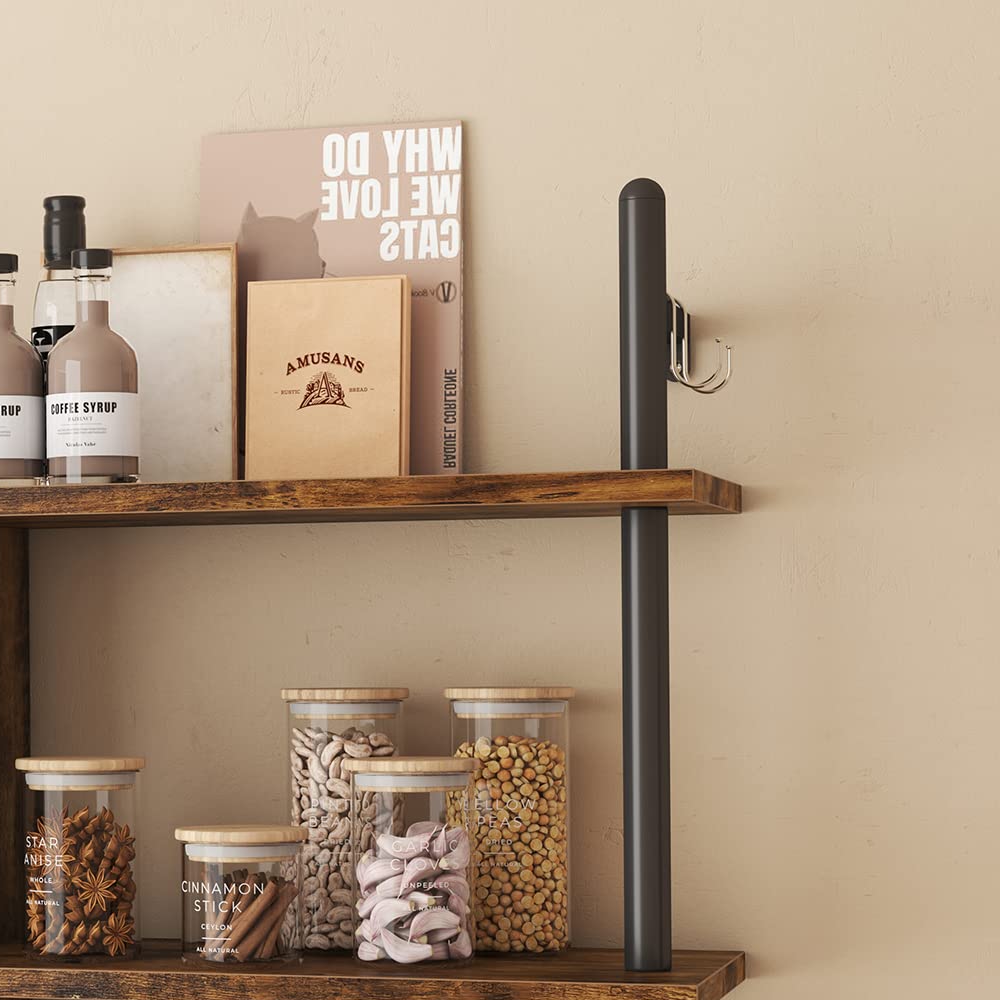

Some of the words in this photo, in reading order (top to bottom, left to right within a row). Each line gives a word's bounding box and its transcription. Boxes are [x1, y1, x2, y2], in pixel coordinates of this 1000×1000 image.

[286, 351, 365, 376] AMUSANS
[50, 402, 79, 415] COFFEE
[83, 401, 118, 413] SYRUP
[477, 815, 523, 829] PEAS
[26, 836, 59, 849] STAR
[392, 840, 459, 853] GARLIC
[24, 854, 63, 867] ANISE
[181, 881, 264, 895] CINNAMON
[403, 881, 450, 889] UNPEELED
[194, 900, 243, 913] STICK
[200, 923, 233, 931] CEYLON
